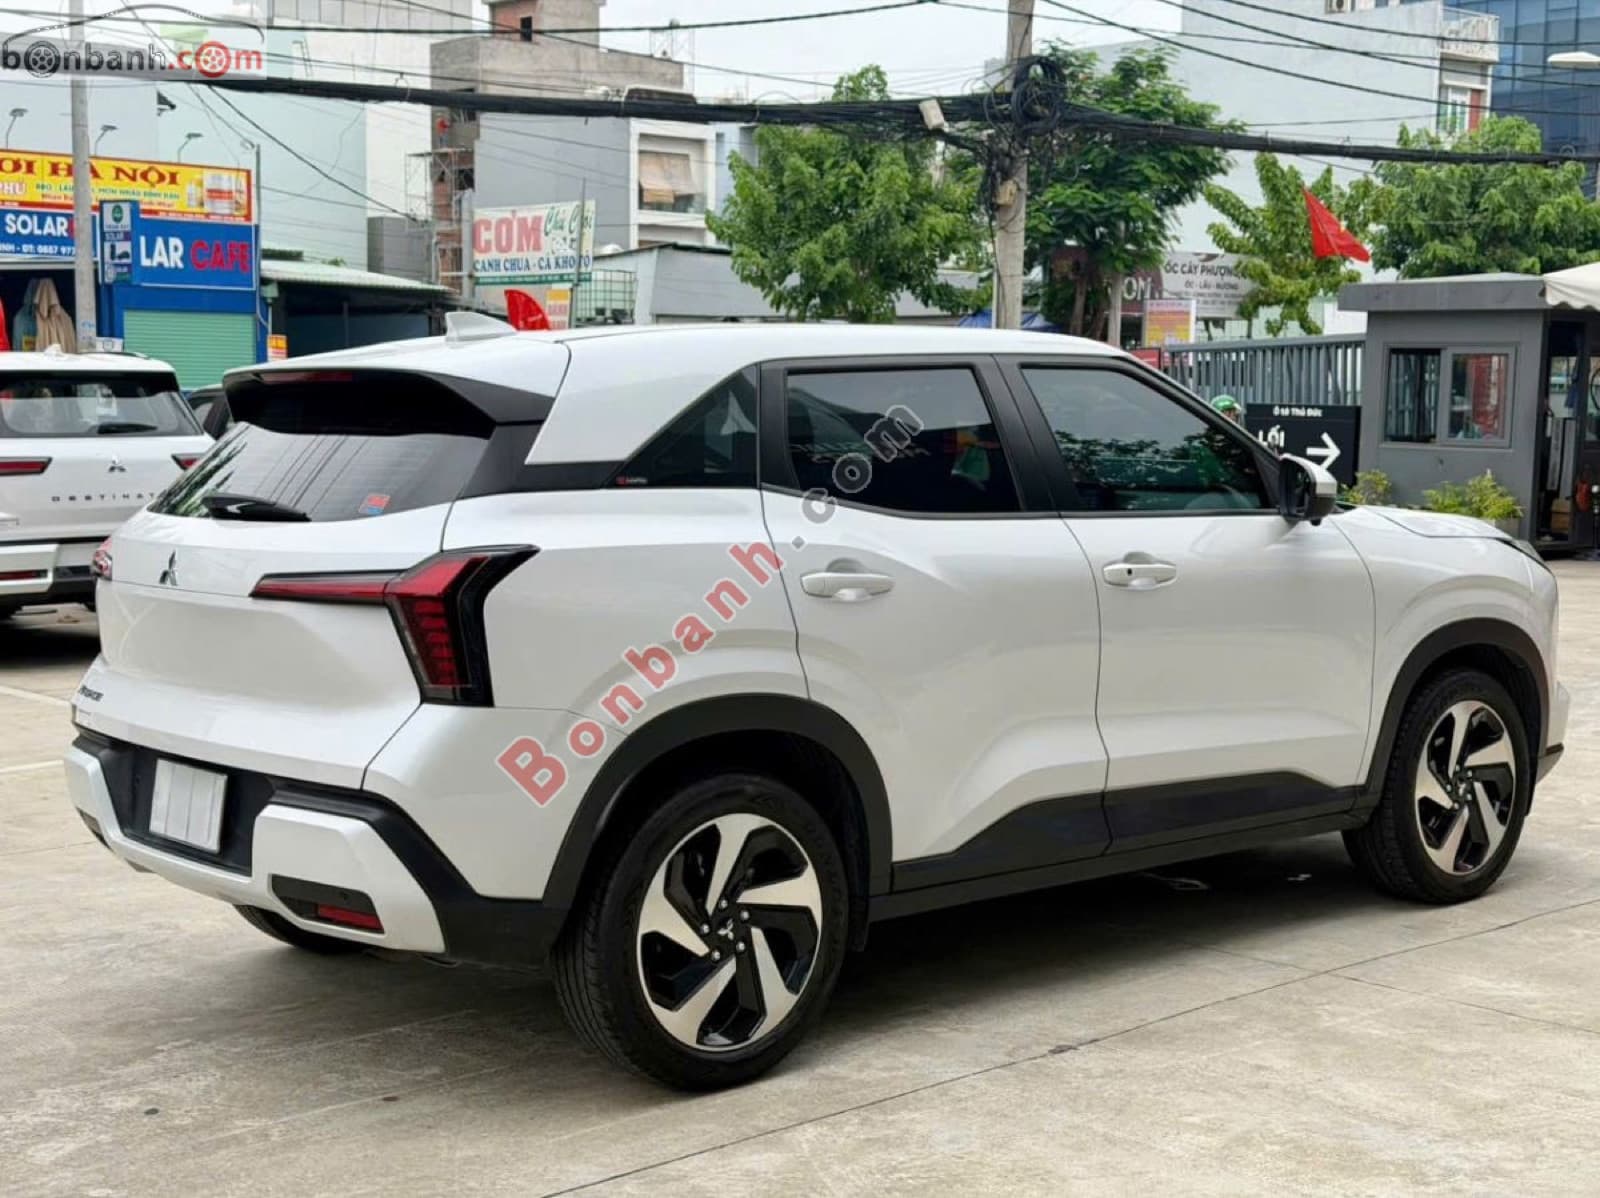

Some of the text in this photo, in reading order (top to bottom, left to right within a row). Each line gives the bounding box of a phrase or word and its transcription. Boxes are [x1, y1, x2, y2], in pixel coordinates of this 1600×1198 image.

[112, 165, 181, 188] NỘI
[5, 212, 69, 237] SOLAR
[474, 209, 544, 254] CƠM
[190, 240, 250, 273] CAFE
[474, 259, 500, 273] CANH
[503, 258, 530, 272] CHUA
[554, 256, 576, 270] KHO
